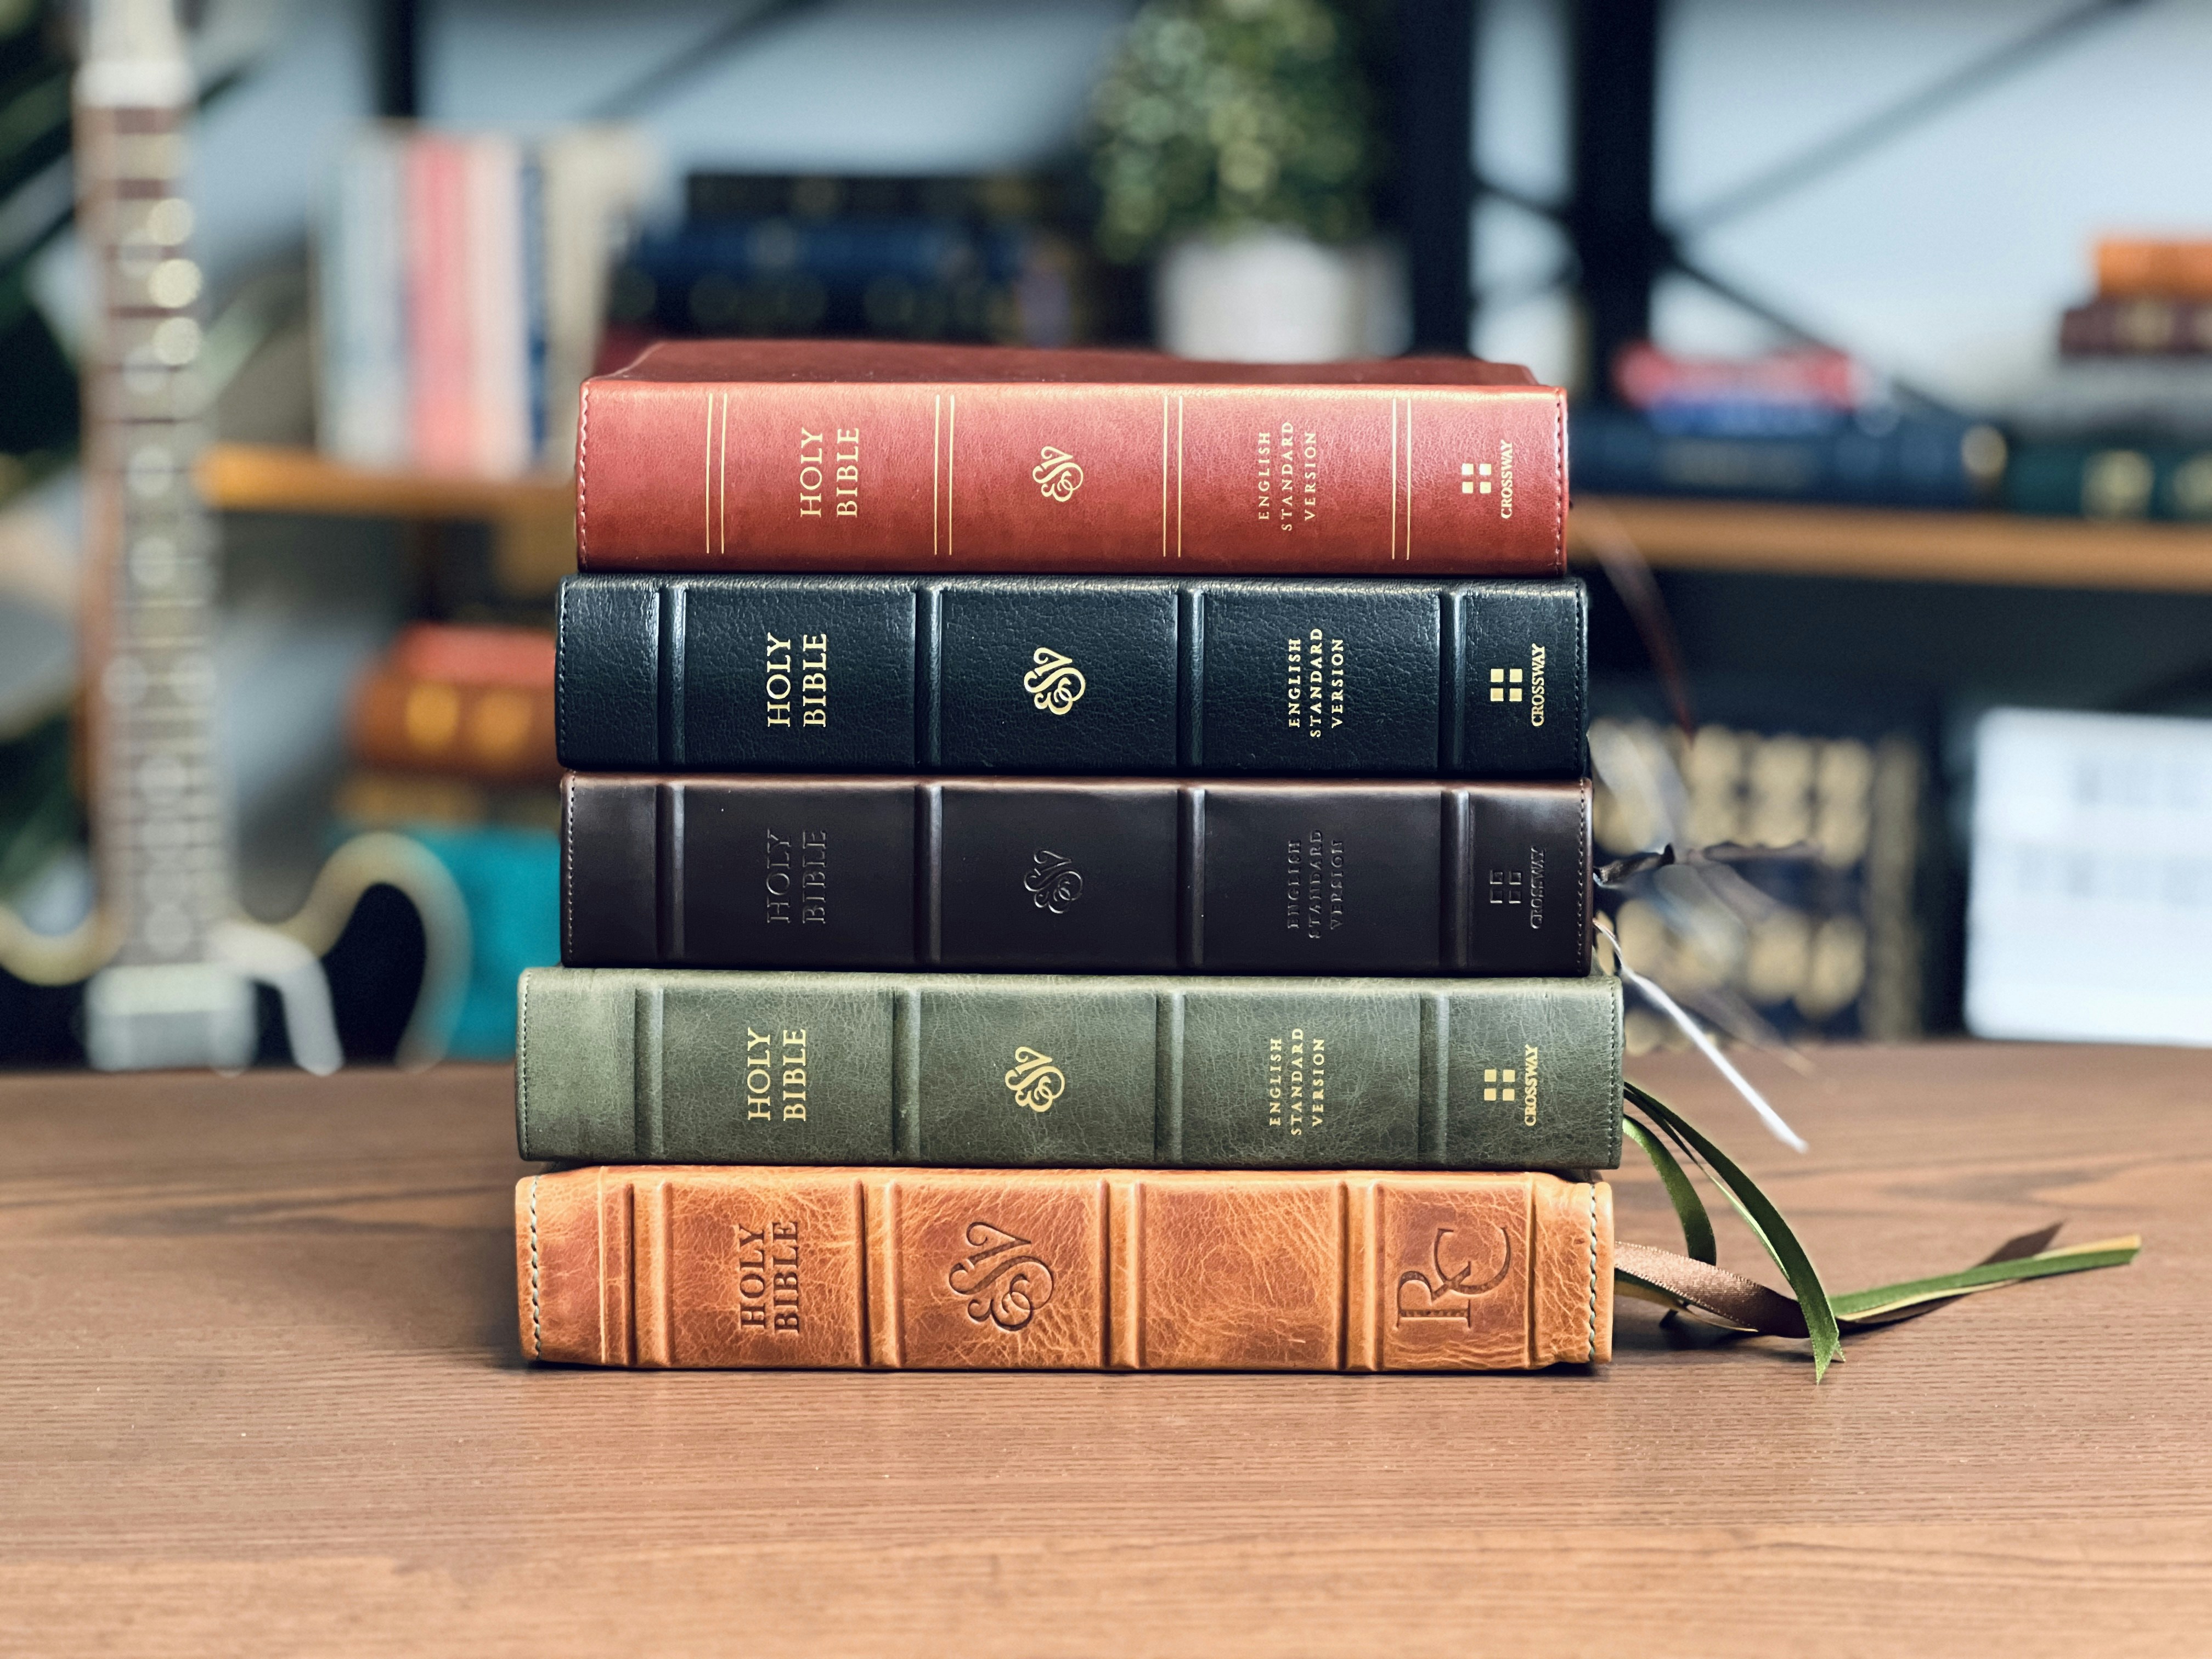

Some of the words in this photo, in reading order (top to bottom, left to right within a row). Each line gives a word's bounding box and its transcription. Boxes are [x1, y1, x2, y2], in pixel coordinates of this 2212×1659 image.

[800, 427, 823, 518] HOLY
[837, 427, 859, 518] BIBLE
[1259, 431, 1271, 521] ENGLISH
[1282, 421, 1294, 531] STANDARD
[1305, 430, 1317, 521] VERSION
[1500, 439, 1514, 519] CROSSWAY
[767, 632, 791, 727] HOLY
[803, 633, 827, 727] BIBLE
[1289, 637, 1302, 729] ENGLISH
[1311, 627, 1323, 738] STANDARD
[1331, 637, 1344, 729] VERSION
[1531, 642, 1546, 727] CROSSWAY
[766, 828, 793, 924] HOLY
[802, 829, 828, 925] BIBLE
[1287, 839, 1302, 930] ENGLISH
[1308, 829, 1323, 940] STANDARD
[1330, 839, 1345, 930] VERSION
[1530, 845, 1547, 930] CROSSWAY
[747, 1026, 772, 1121] HOLY
[783, 1028, 807, 1122] BIBLE
[1269, 1037, 1283, 1127] ENGLISH
[1290, 1028, 1304, 1136] STANDARD
[1312, 1037, 1325, 1127] VERSION
[1523, 1043, 1538, 1127] CROSSWAY
[738, 1222, 766, 1332] HOLY
[774, 1220, 800, 1334] BIBLE
